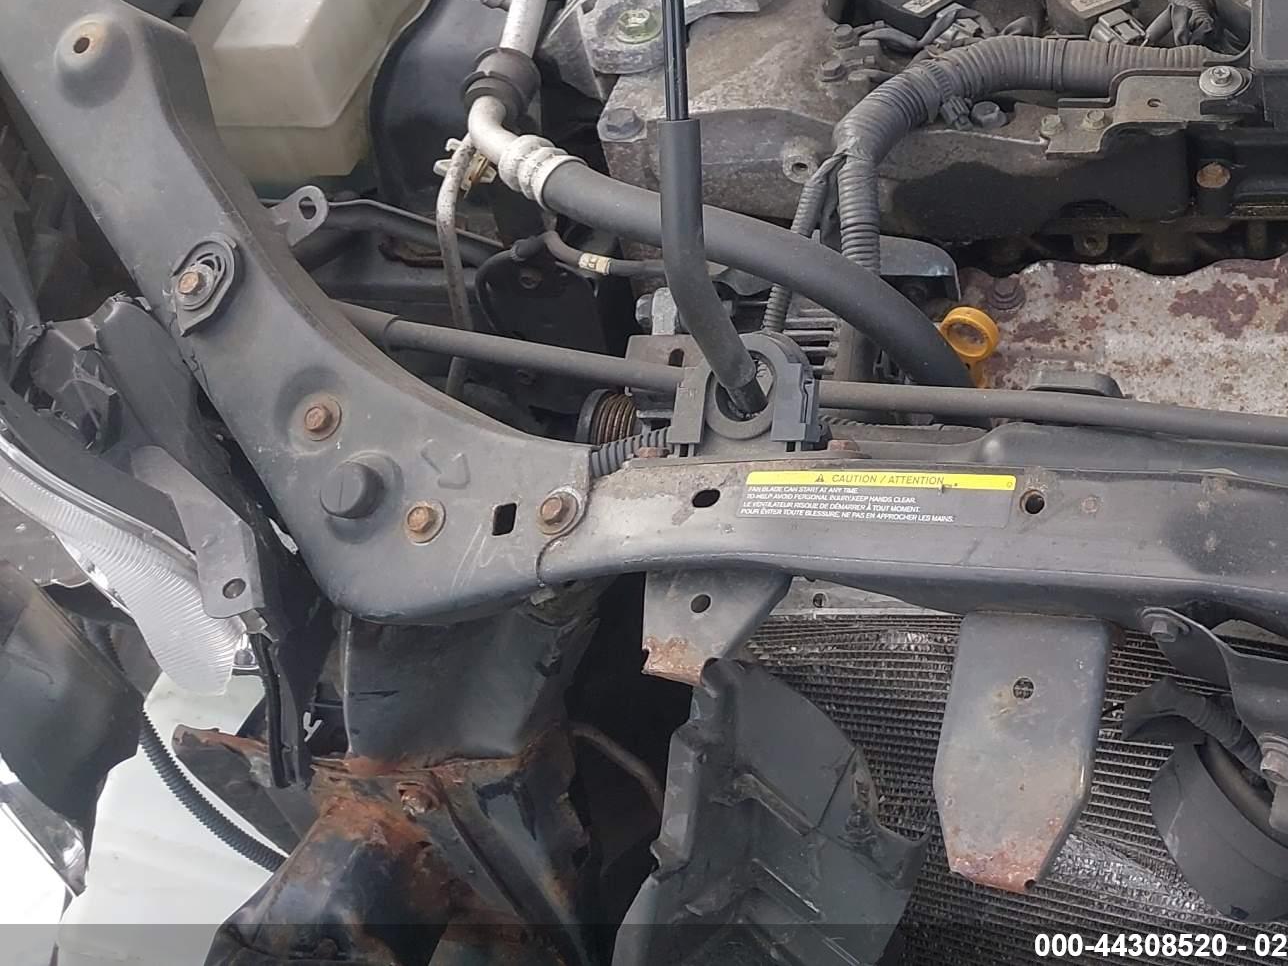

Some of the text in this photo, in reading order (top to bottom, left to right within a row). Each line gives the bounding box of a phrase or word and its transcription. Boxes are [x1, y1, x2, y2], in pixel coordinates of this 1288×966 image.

[831, 474, 945, 485] CAUTION / ATTENTION
[829, 502, 865, 511] DÉMARRER
[890, 505, 921, 513] MOMENT.
[760, 507, 783, 515] ÉVITER
[876, 513, 917, 521] APPROCHER
[931, 515, 954, 523] MAINS.
